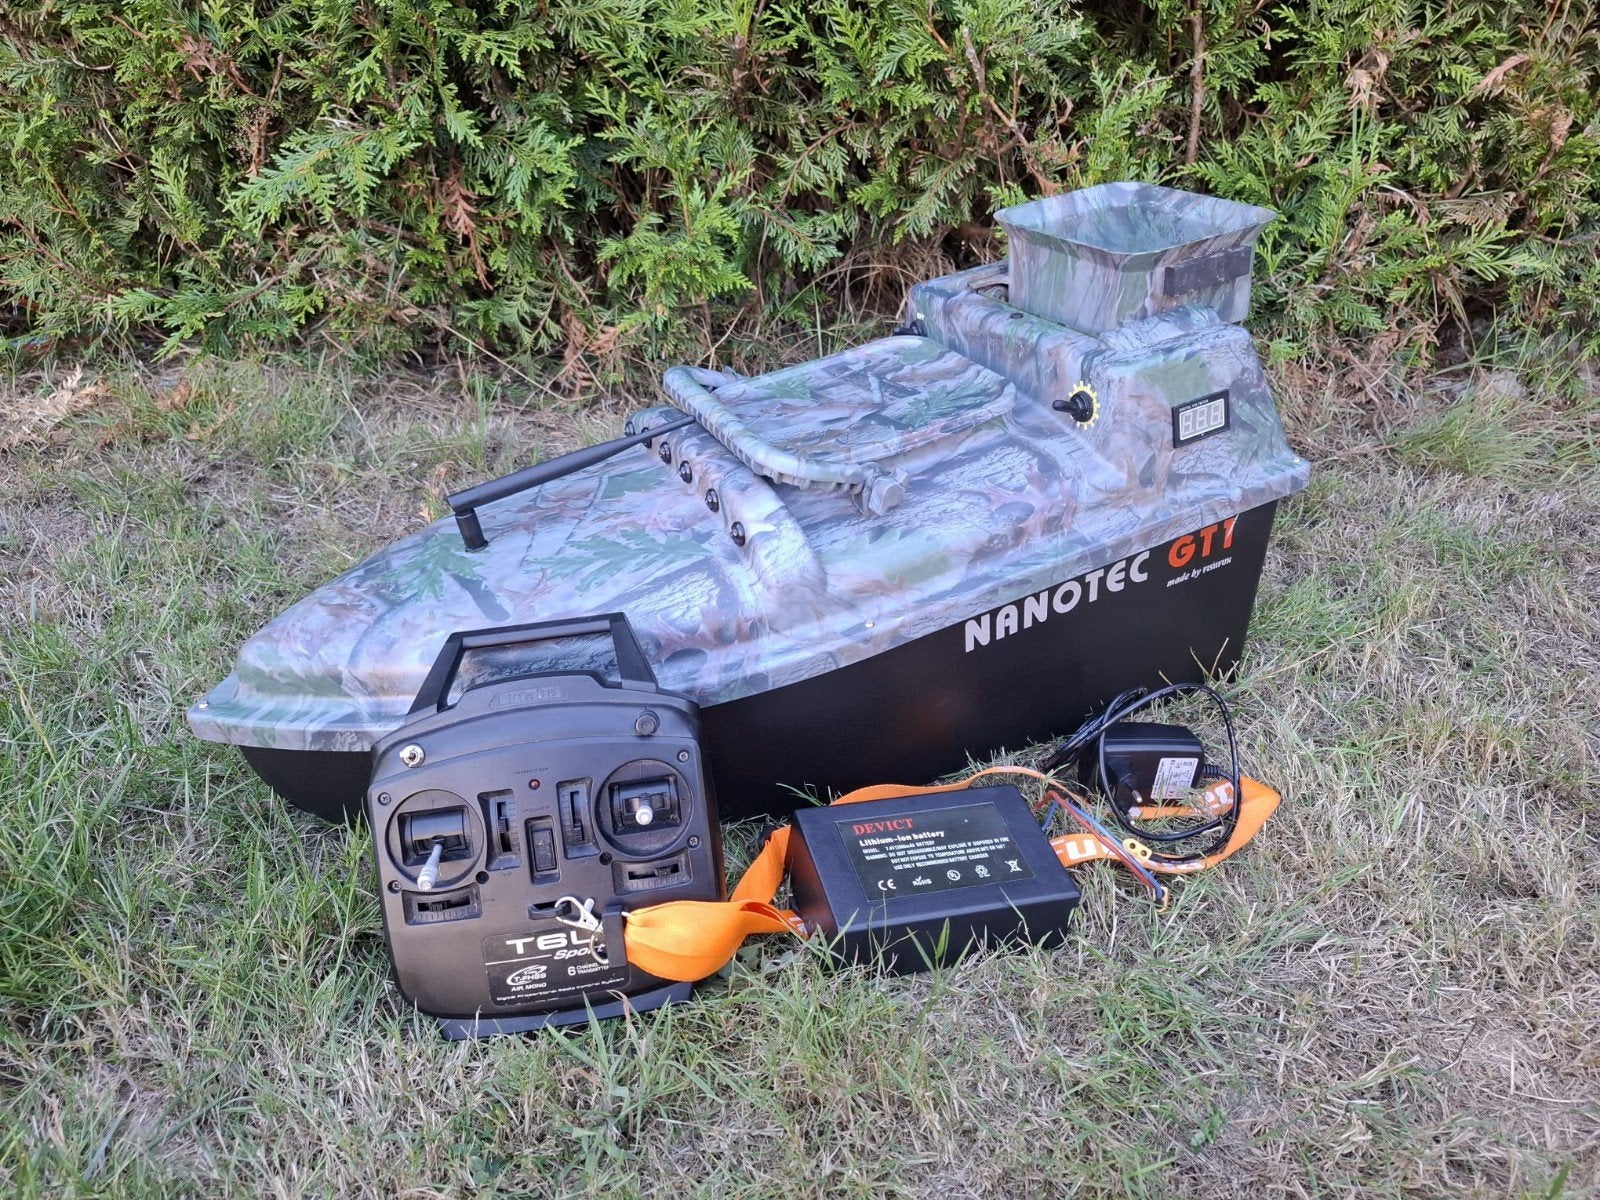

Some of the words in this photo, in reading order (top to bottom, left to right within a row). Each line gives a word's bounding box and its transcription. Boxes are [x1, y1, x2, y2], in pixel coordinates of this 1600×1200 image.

[1166, 572, 1190, 588] made
[1190, 568, 1202, 578] by
[964, 550, 1150, 653] NANOTEC
[852, 818, 914, 836] DEVICT
[859, 834, 912, 847] Lithium-ion
[912, 830, 945, 840] battery
[568, 966, 576, 976] 6
